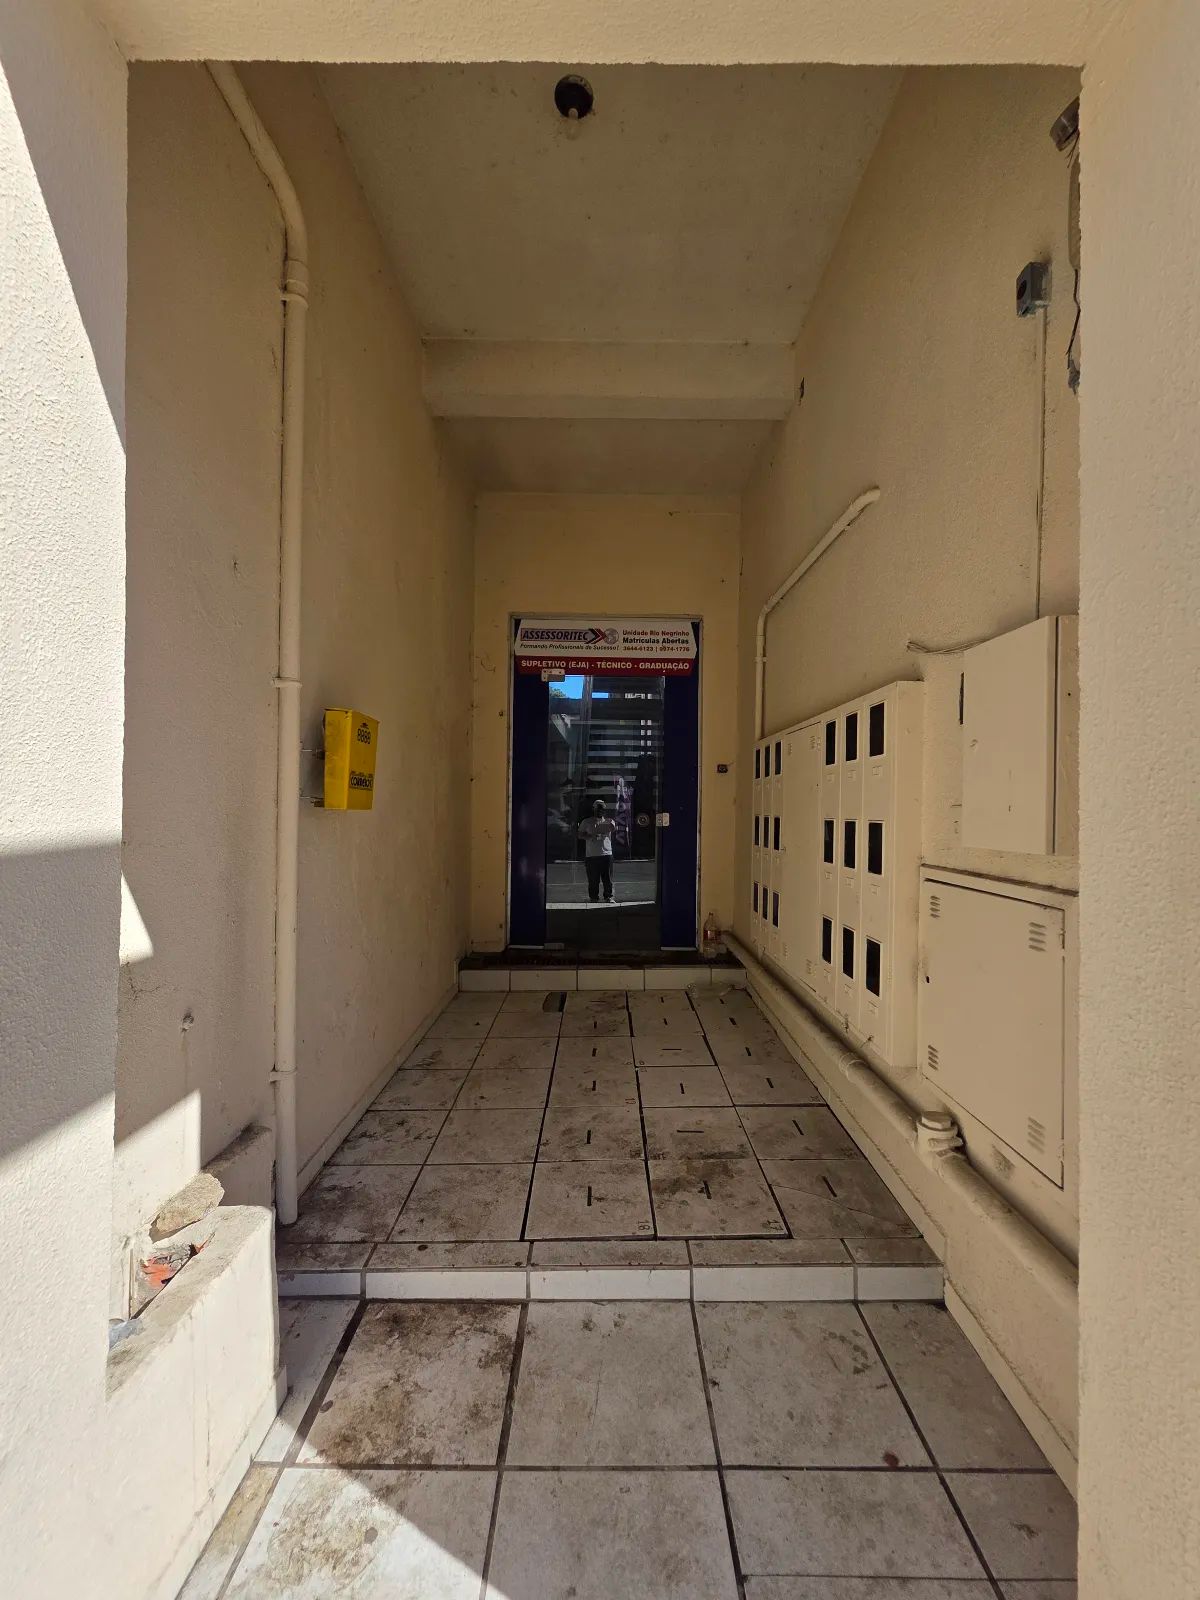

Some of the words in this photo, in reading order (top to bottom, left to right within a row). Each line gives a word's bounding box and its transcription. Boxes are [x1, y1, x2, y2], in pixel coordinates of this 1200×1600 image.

[523, 631, 589, 640] ASSESSORITEC
[661, 637, 689, 645] Abertas
[521, 660, 566, 668] SUPLETIVO
[568, 660, 589, 669] (EJA)
[596, 659, 632, 669] TÉCNICO
